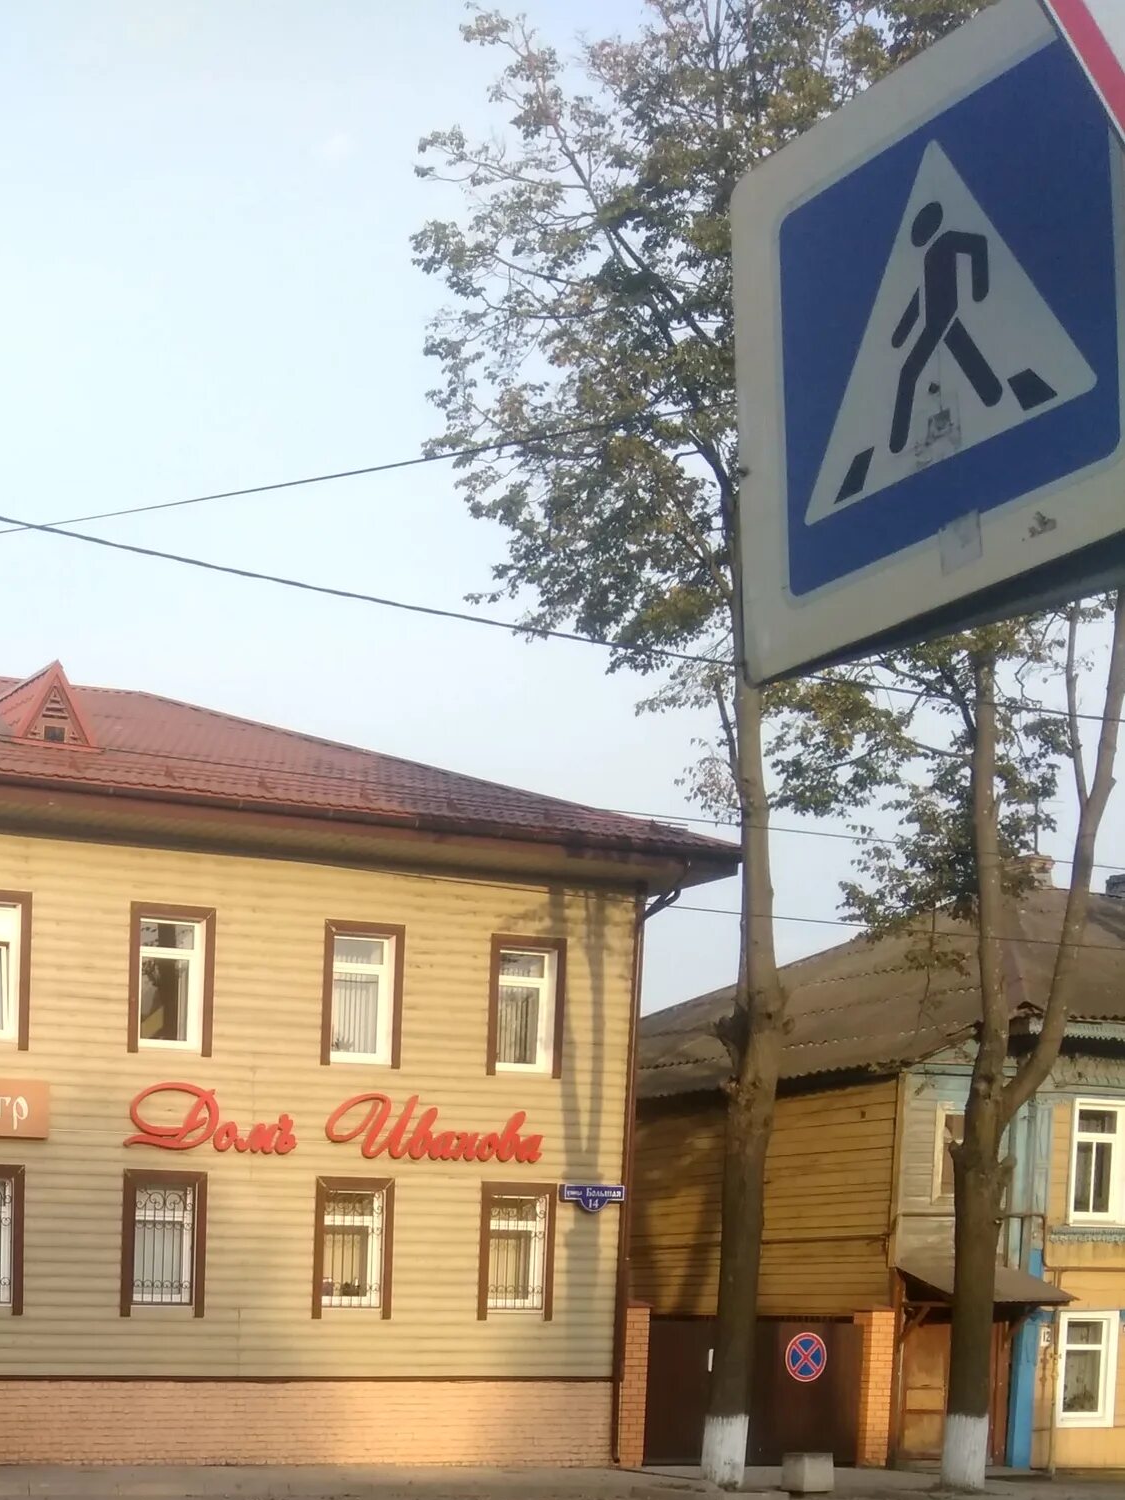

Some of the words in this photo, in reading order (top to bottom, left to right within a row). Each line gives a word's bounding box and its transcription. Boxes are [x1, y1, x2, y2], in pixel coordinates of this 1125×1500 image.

[123, 1081, 298, 1155] Домъ
[325, 1092, 544, 1164] Иванова
[586, 1188, 621, 1197] Большая
[588, 1199, 599, 1209] 14
